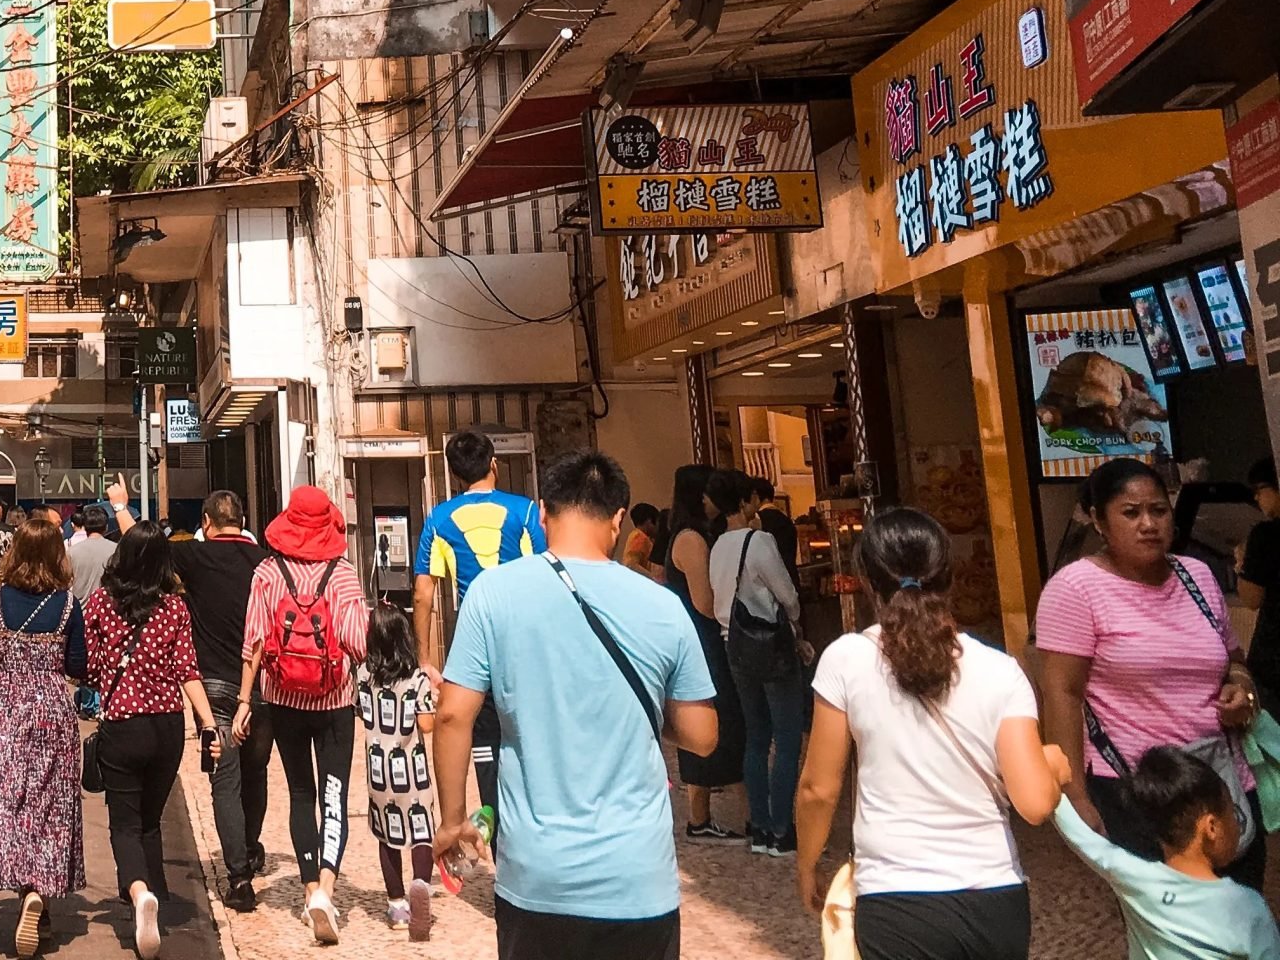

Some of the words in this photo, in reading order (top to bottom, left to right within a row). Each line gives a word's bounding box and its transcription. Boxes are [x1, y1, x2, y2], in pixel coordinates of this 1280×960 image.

[885, 35, 995, 163] 貓山王
[617, 143, 650, 159] 馳名
[657, 137, 765, 169] 貓山王
[895, 102, 1055, 258] 榴槤雪糕
[637, 176, 781, 213] 榴槤雪糕
[1075, 329, 1140, 348] 豬扒包
[145, 353, 187, 363] NATURE
[1046, 438, 1073, 448] PORK
[1076, 437, 1102, 446] CHOP
[1105, 436, 1126, 445] BUN
